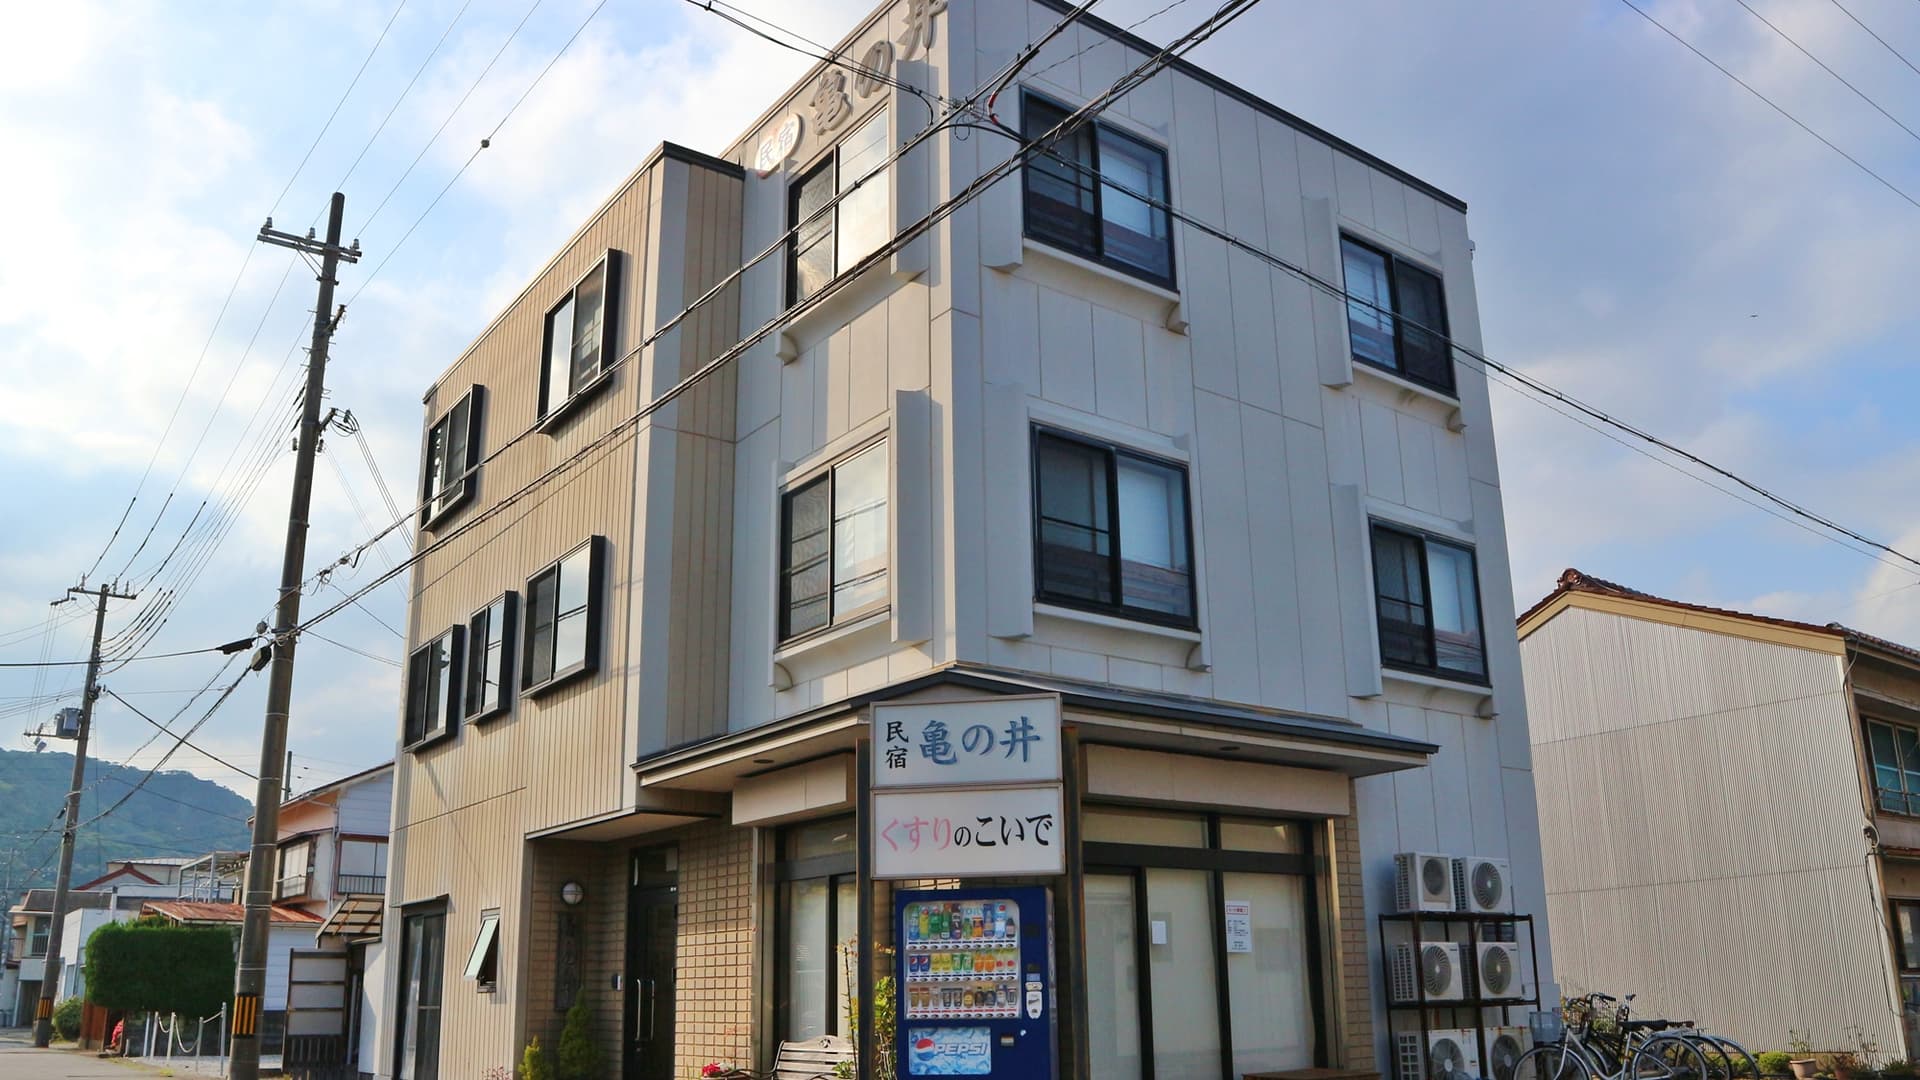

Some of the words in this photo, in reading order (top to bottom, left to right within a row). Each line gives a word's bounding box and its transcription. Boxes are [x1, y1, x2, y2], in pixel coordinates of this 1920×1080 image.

[886, 721, 909, 769] 民宿
[919, 716, 1041, 765] 亀の井
[881, 814, 1053, 852] くすりのこいで
[935, 1043, 988, 1057] PEPSI
